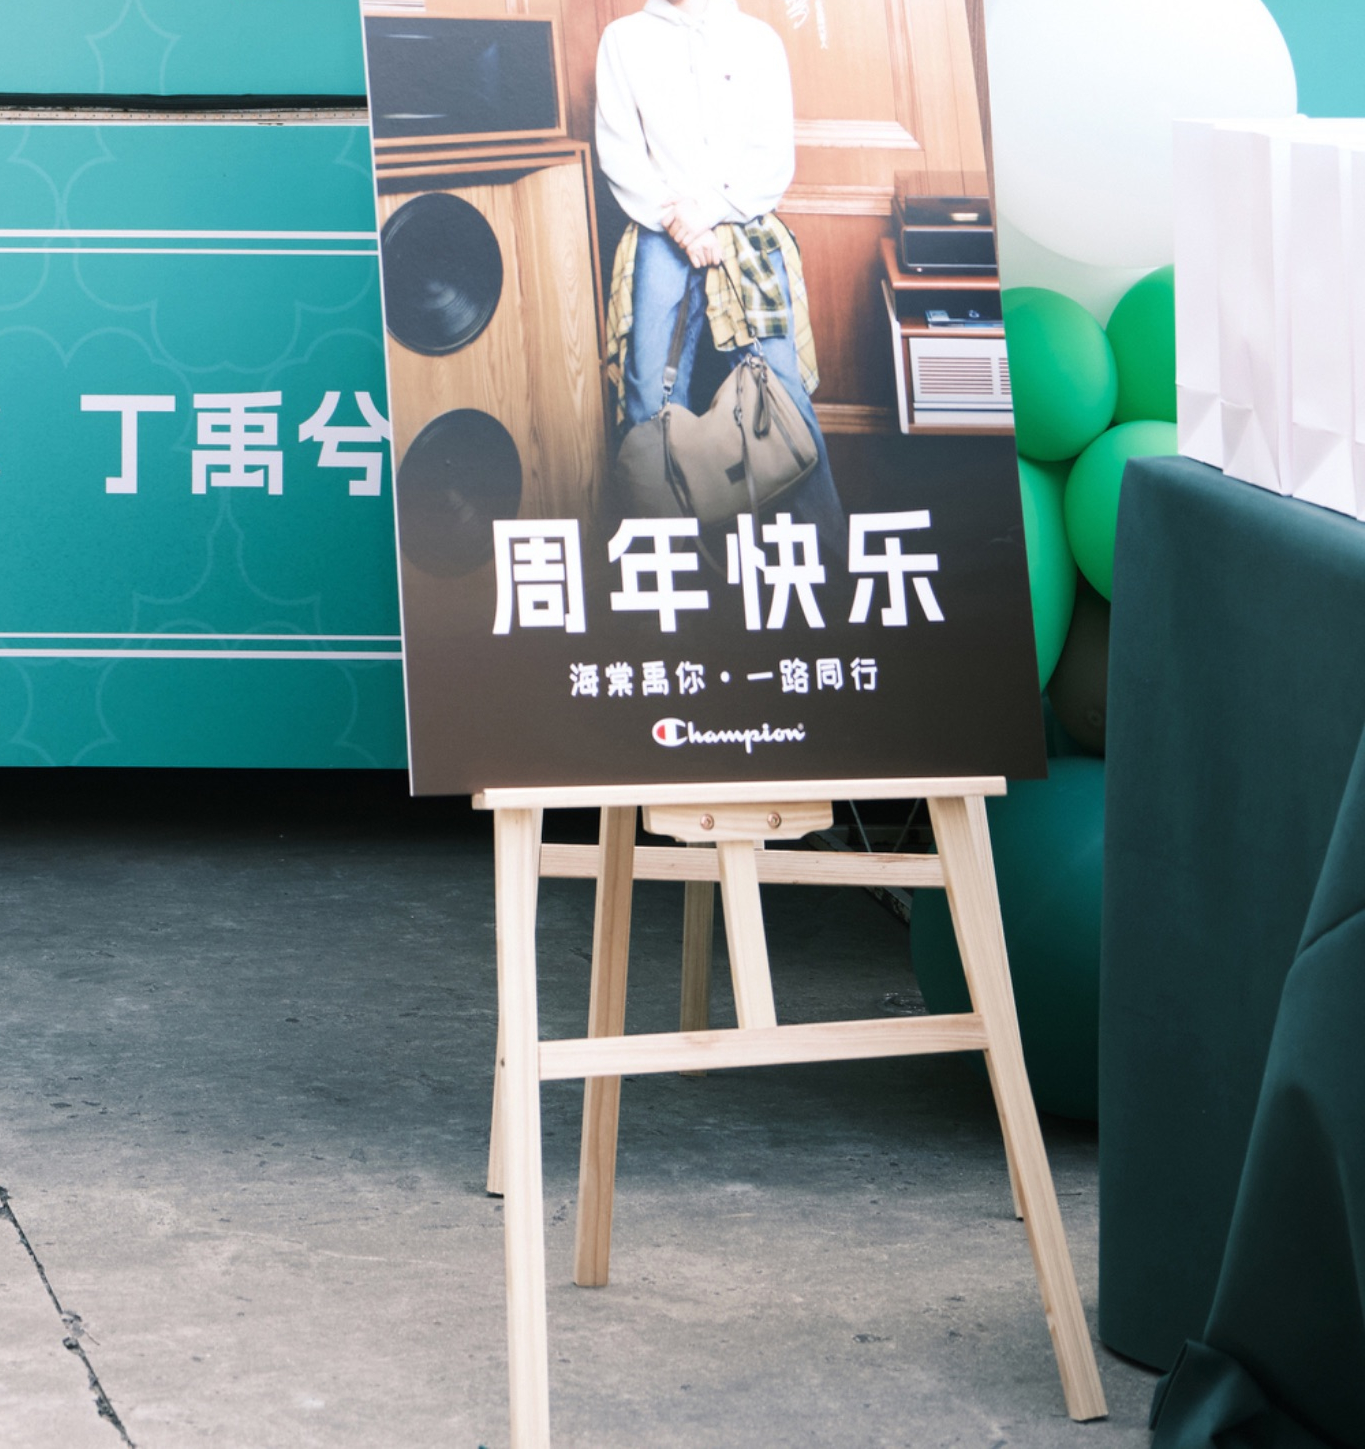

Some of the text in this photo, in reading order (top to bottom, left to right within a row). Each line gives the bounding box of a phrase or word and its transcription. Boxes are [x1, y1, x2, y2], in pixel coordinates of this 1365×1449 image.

[80, 390, 391, 498] 丁禹兮
[491, 509, 946, 636] 周年快乐
[651, 717, 807, 754] Champion
